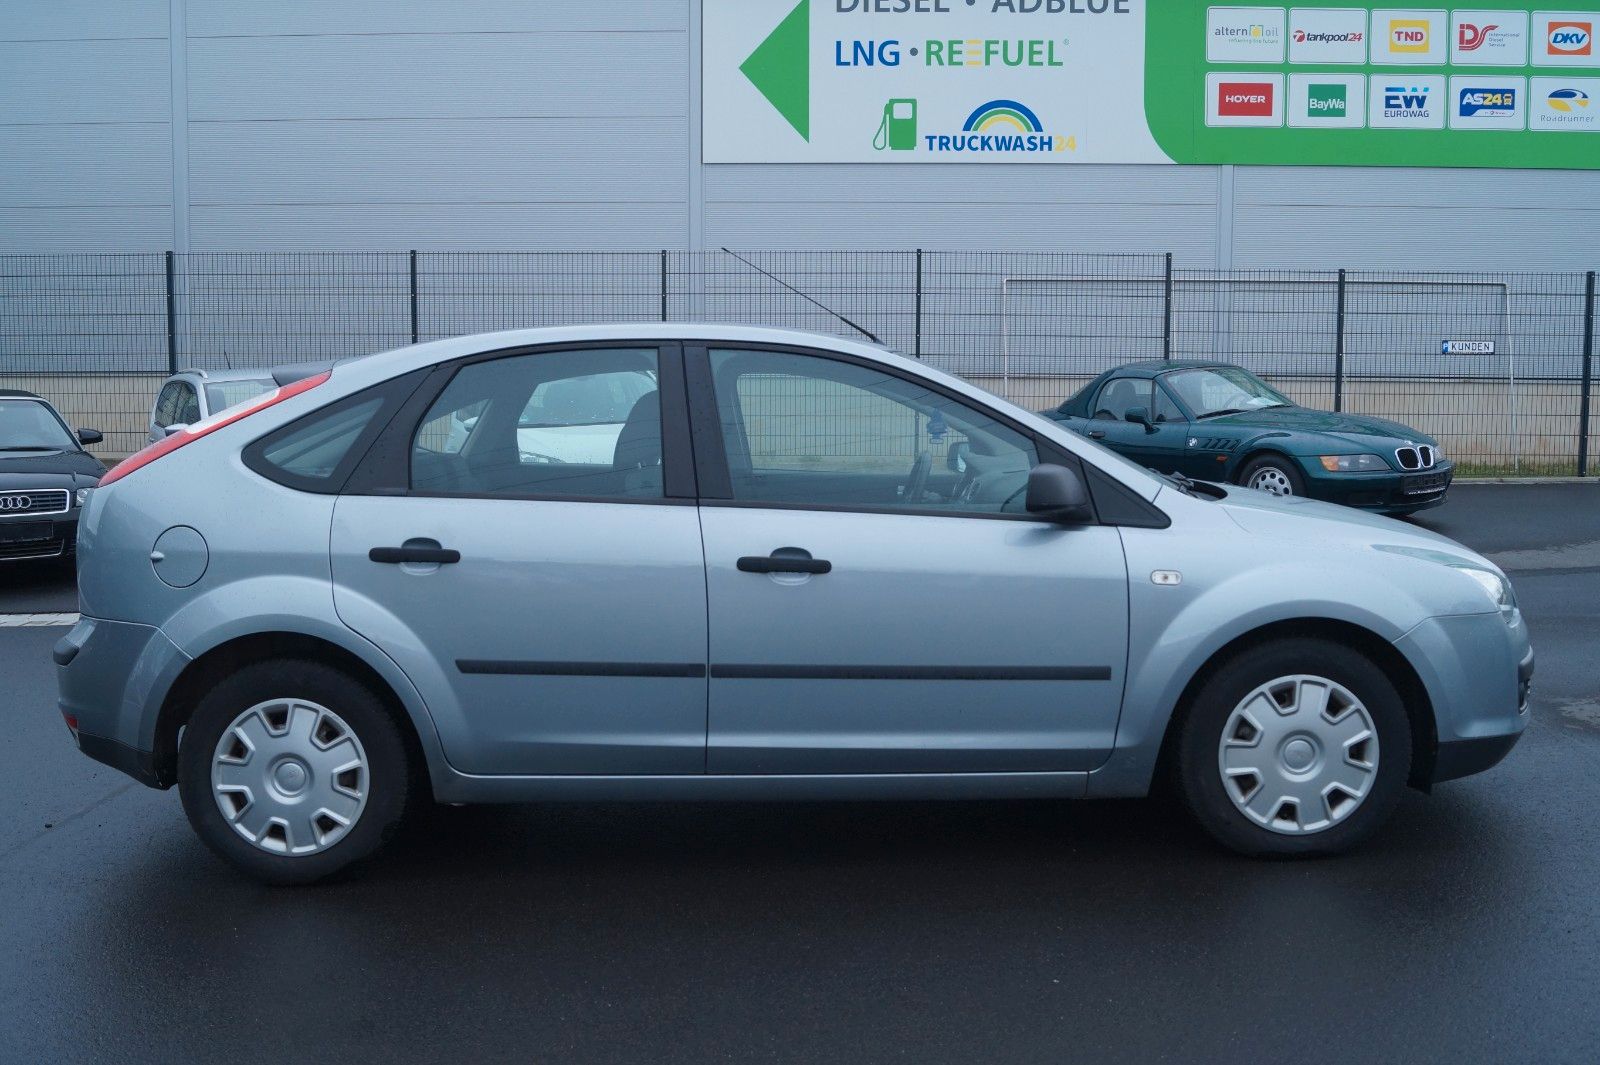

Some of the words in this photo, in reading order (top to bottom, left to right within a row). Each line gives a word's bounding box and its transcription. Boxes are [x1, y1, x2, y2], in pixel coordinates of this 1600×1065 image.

[1306, 32, 1363, 44] tankpool24
[1394, 31, 1424, 42] TND
[1552, 32, 1587, 44] DKV
[835, 40, 900, 67] LNG
[1225, 94, 1266, 104] HOYER
[1309, 98, 1345, 111] BayWa
[1461, 92, 1503, 106] AS24
[1384, 110, 1430, 118] EUROWAG
[1540, 114, 1595, 123] Roadrunner
[1451, 342, 1490, 351] KUNDEN
